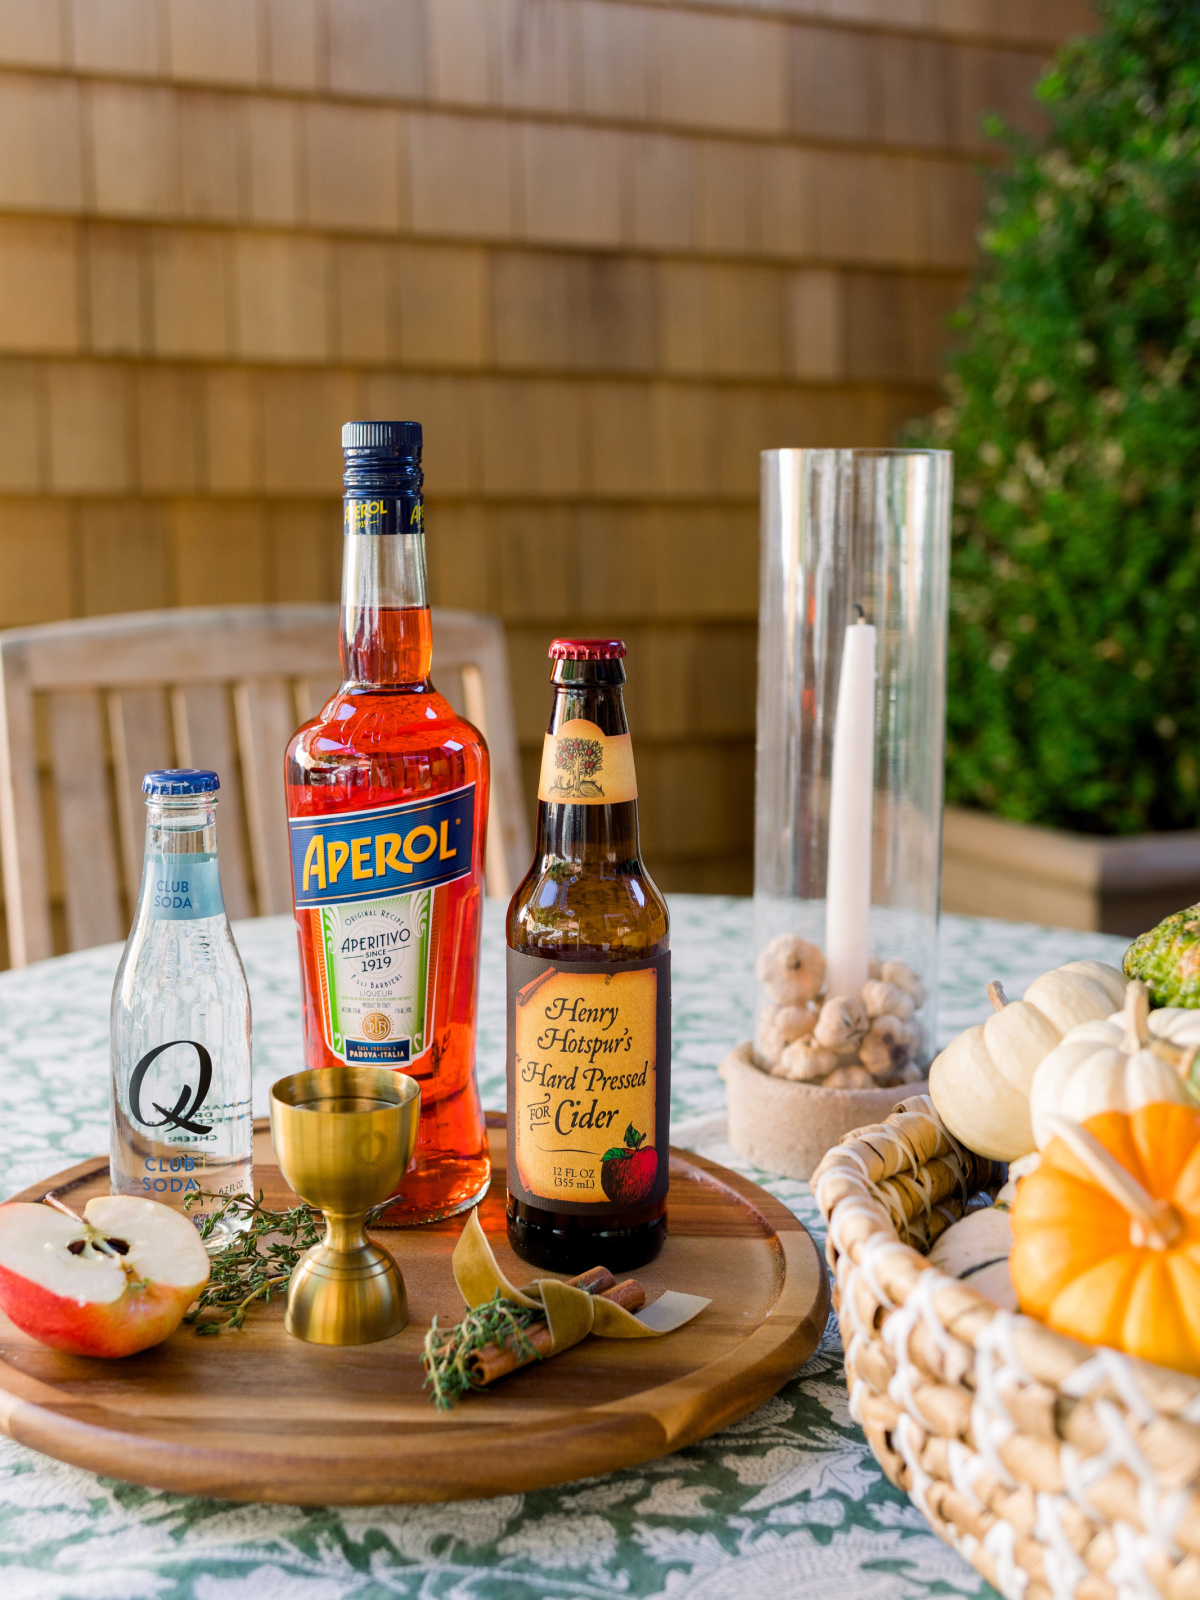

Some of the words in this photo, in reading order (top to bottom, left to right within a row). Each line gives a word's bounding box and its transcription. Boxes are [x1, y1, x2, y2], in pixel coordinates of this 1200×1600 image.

[303, 819, 457, 892] APEROL
[156, 880, 189, 893] CLUB
[154, 895, 193, 909] SODA
[345, 909, 377, 926] ORIGINAL
[380, 909, 405, 927] RECIPE
[341, 928, 411, 953] APERITIVO
[365, 948, 387, 959] SINCE
[361, 956, 392, 973] 1919
[370, 973, 403, 989] BARBIERI
[544, 997, 619, 1031] Henry
[537, 1027, 633, 1064] Hotspur's
[521, 1061, 579, 1091] Hard
[582, 1060, 649, 1092] Pressed
[128, 1040, 213, 1135] Q
[530, 1105, 551, 1121] FOR
[554, 1098, 620, 1136] Cider
[144, 1157, 195, 1173] CLUB
[552, 1166, 562, 1176] 12
[565, 1168, 577, 1178] FL
[579, 1168, 595, 1178] OZ
[142, 1177, 197, 1193] SODA
[554, 1178, 574, 1188] (355
[576, 1179, 595, 1189] mL)
